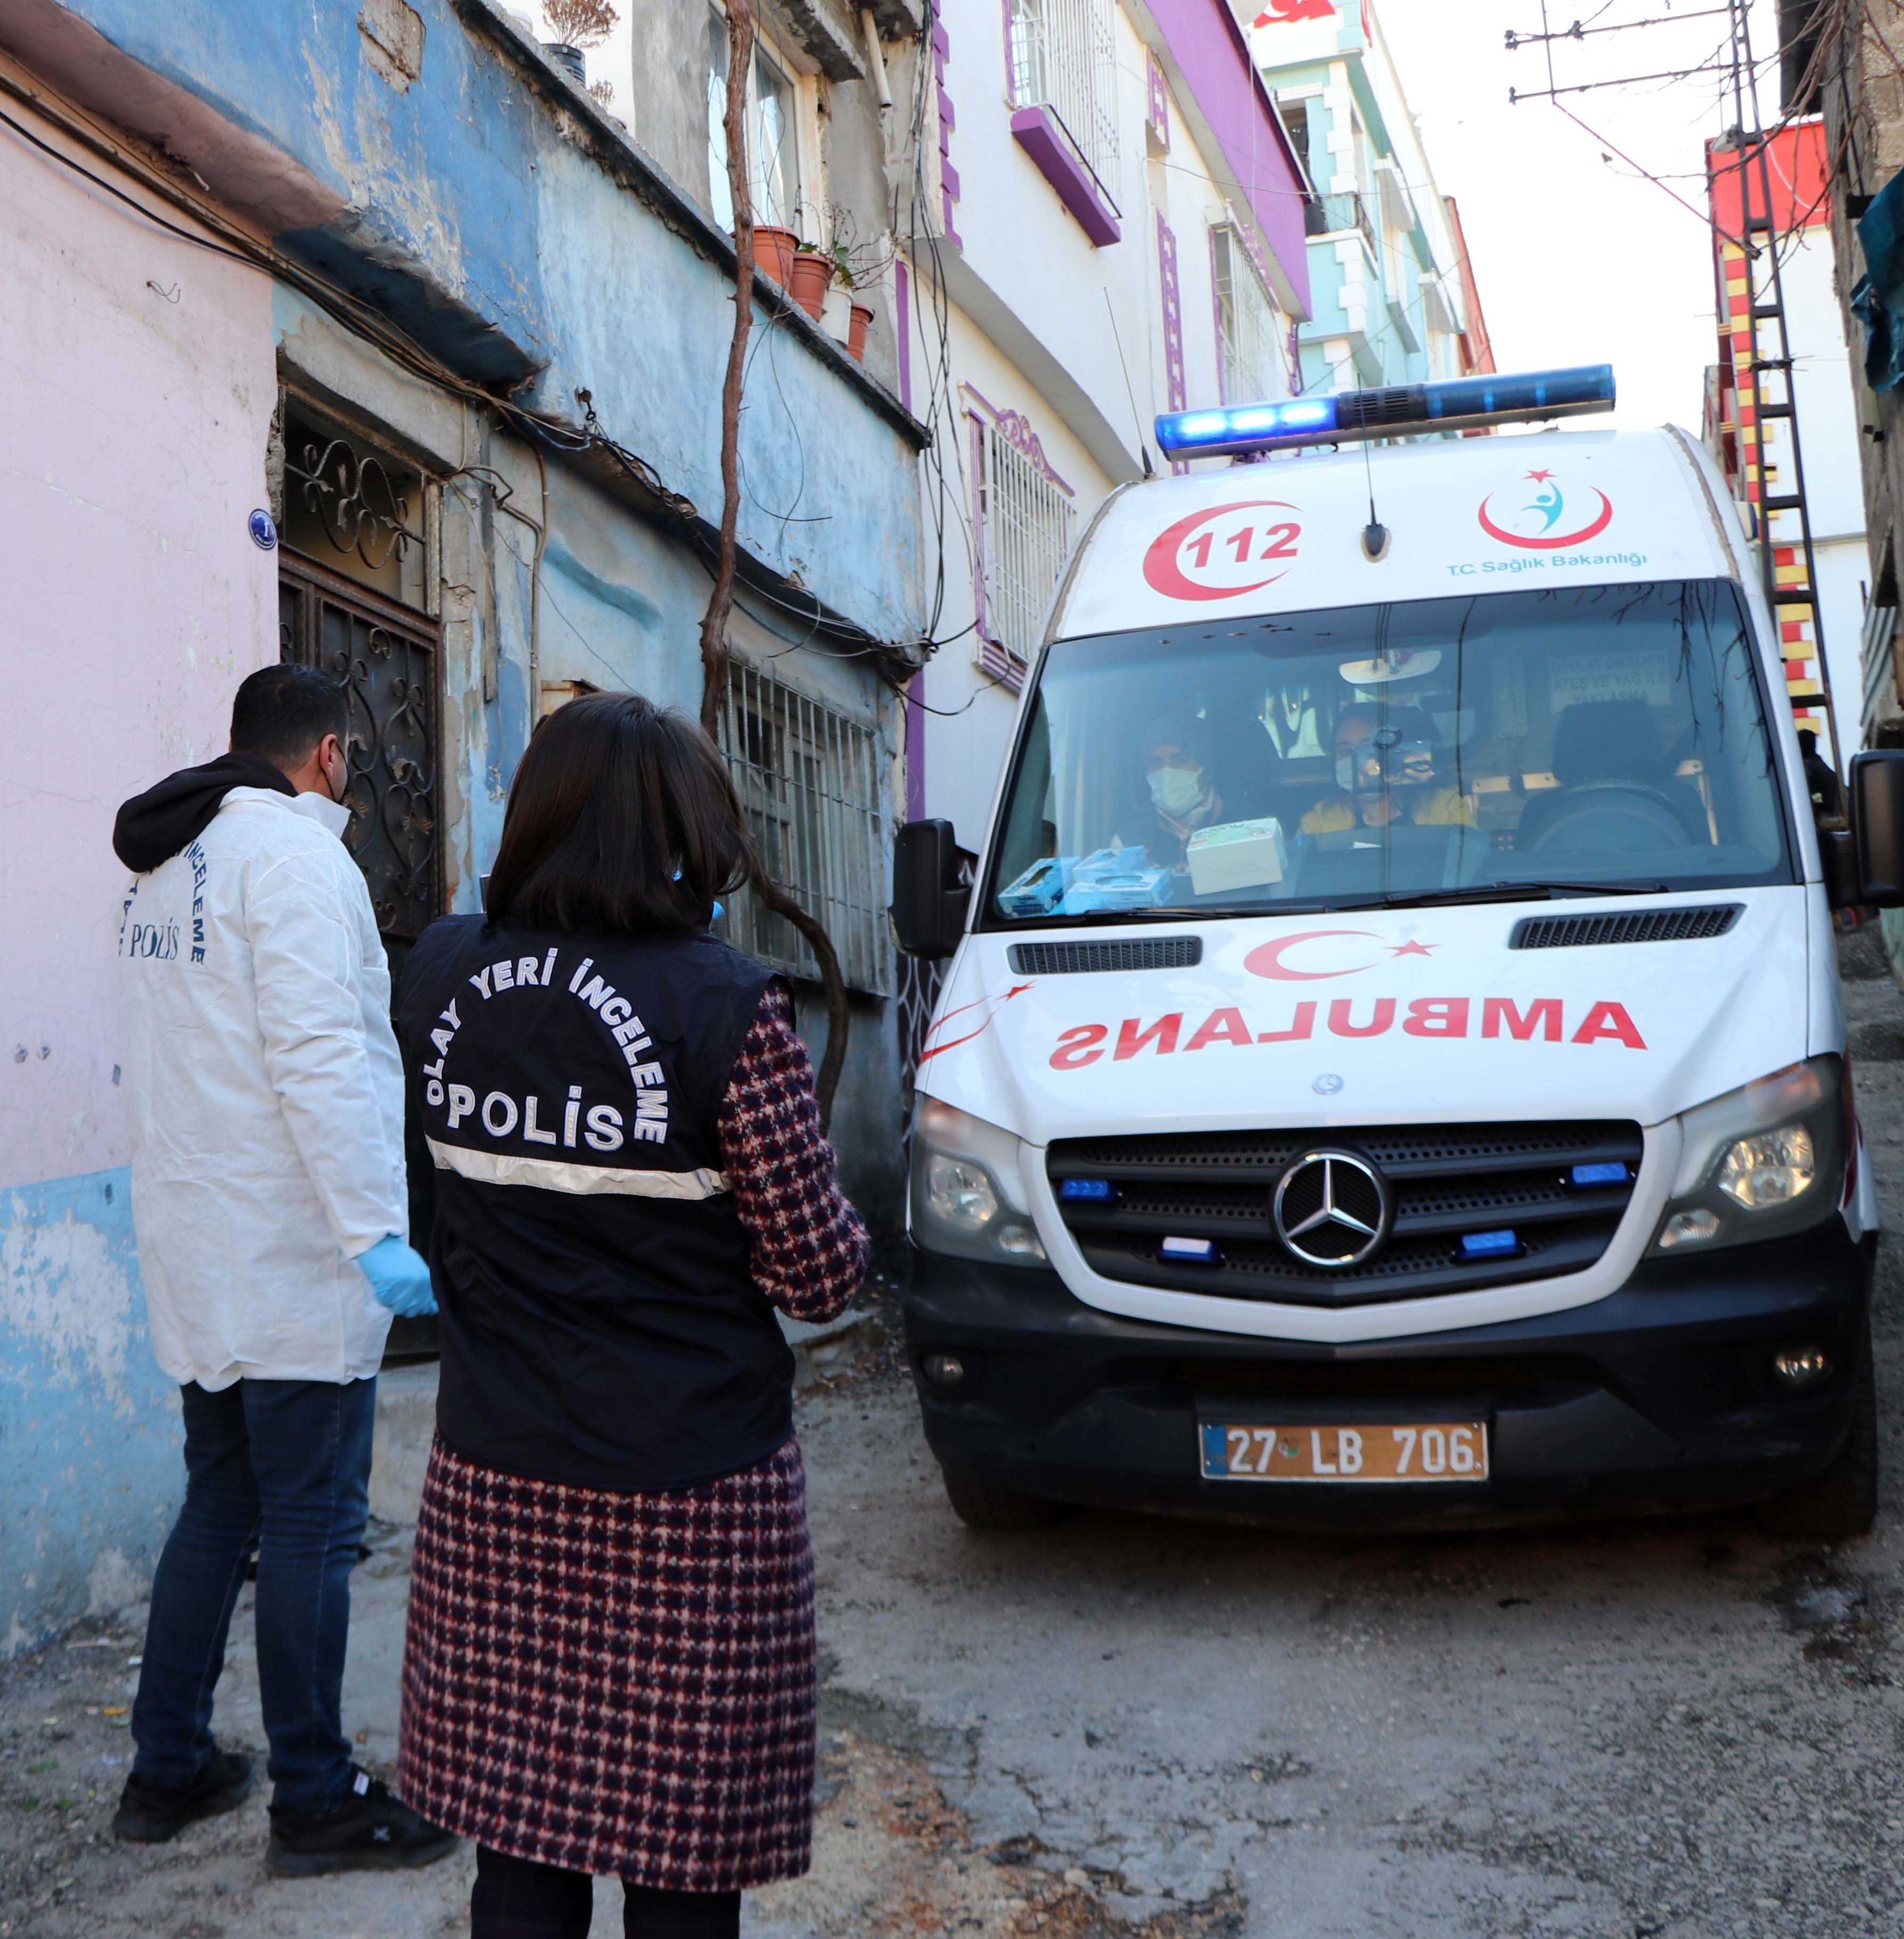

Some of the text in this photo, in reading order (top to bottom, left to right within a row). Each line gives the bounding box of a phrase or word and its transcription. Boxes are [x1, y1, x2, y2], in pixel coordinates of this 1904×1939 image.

[1186, 523, 1301, 568] 112
[1482, 557, 1545, 573] Sağlık
[1552, 553, 1647, 567] Bakanlığı
[1591, 675, 1610, 688] VE
[423, 947, 668, 1145] OLAY YERİ İNCELEME
[447, 1085, 624, 1152] POLİS
[1227, 1428, 1277, 1473] 27
[1310, 1429, 1363, 1474] LB
[1392, 1428, 1474, 1474] 706
